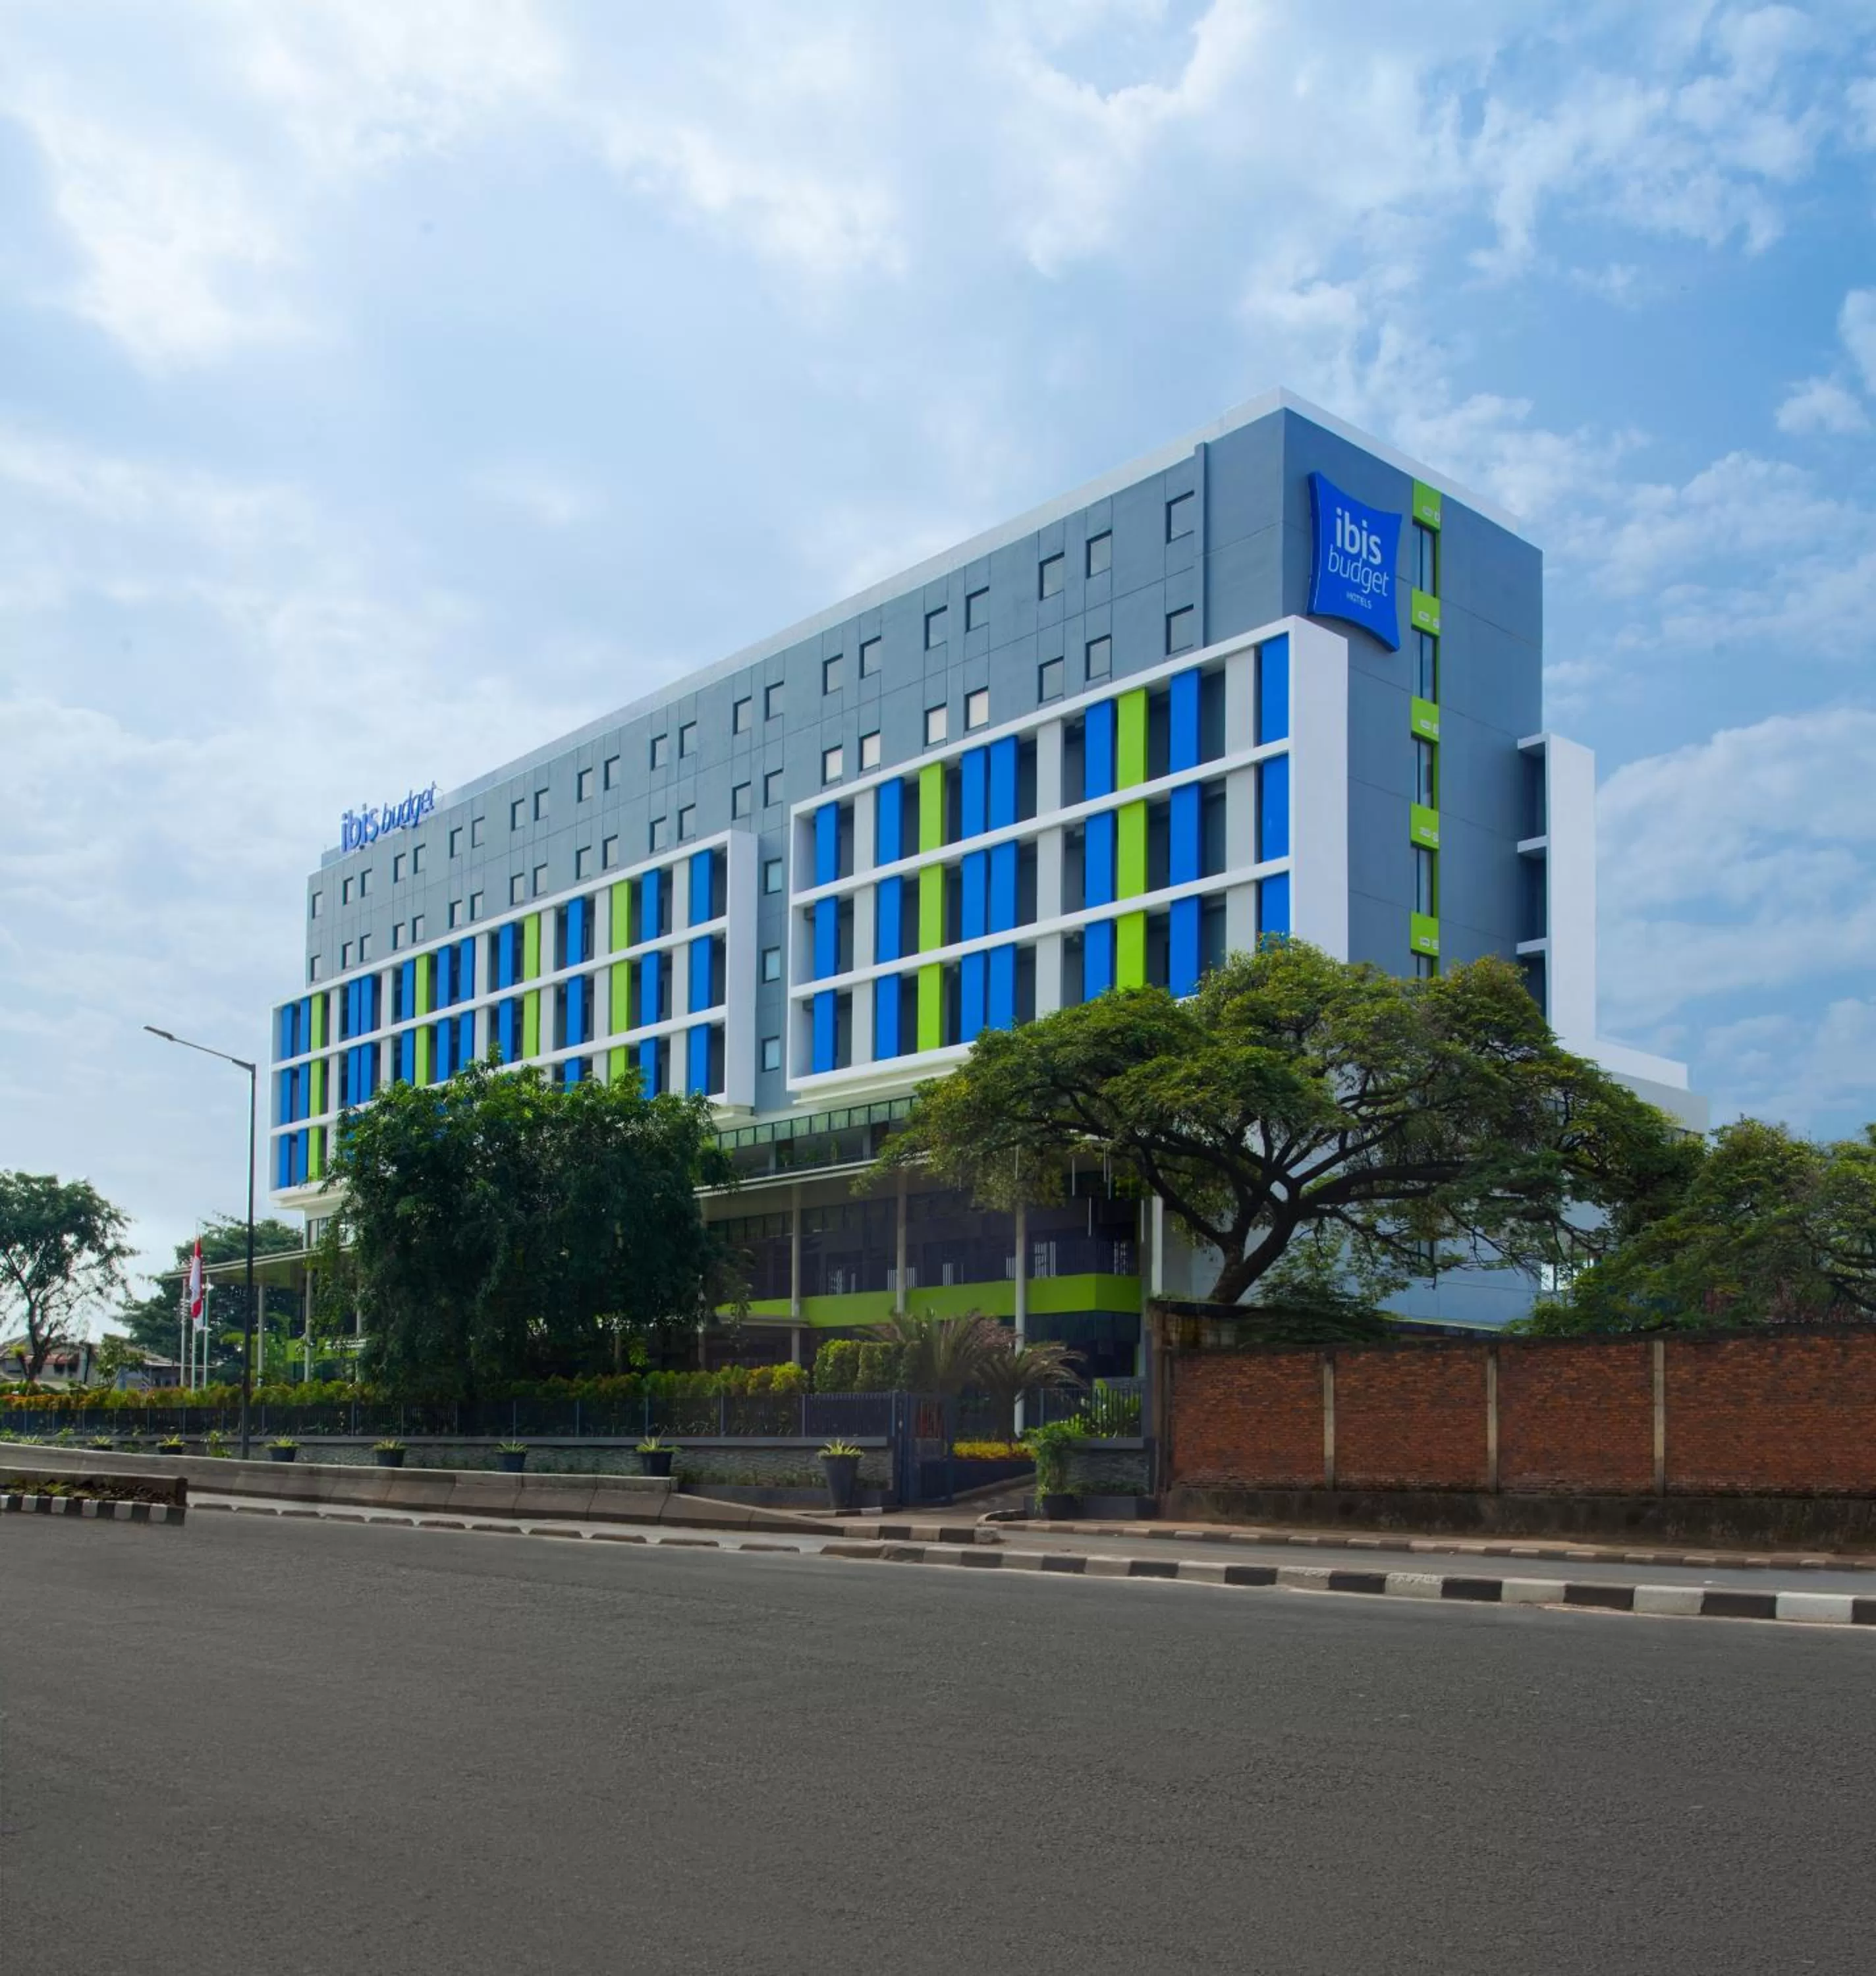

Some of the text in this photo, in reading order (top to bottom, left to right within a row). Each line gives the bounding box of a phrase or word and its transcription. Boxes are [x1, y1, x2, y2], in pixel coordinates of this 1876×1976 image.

[1336, 507, 1381, 564] ibis
[1328, 543, 1389, 597] budget
[1346, 591, 1371, 609] HOTELS
[341, 781, 436, 852] ibis budget
